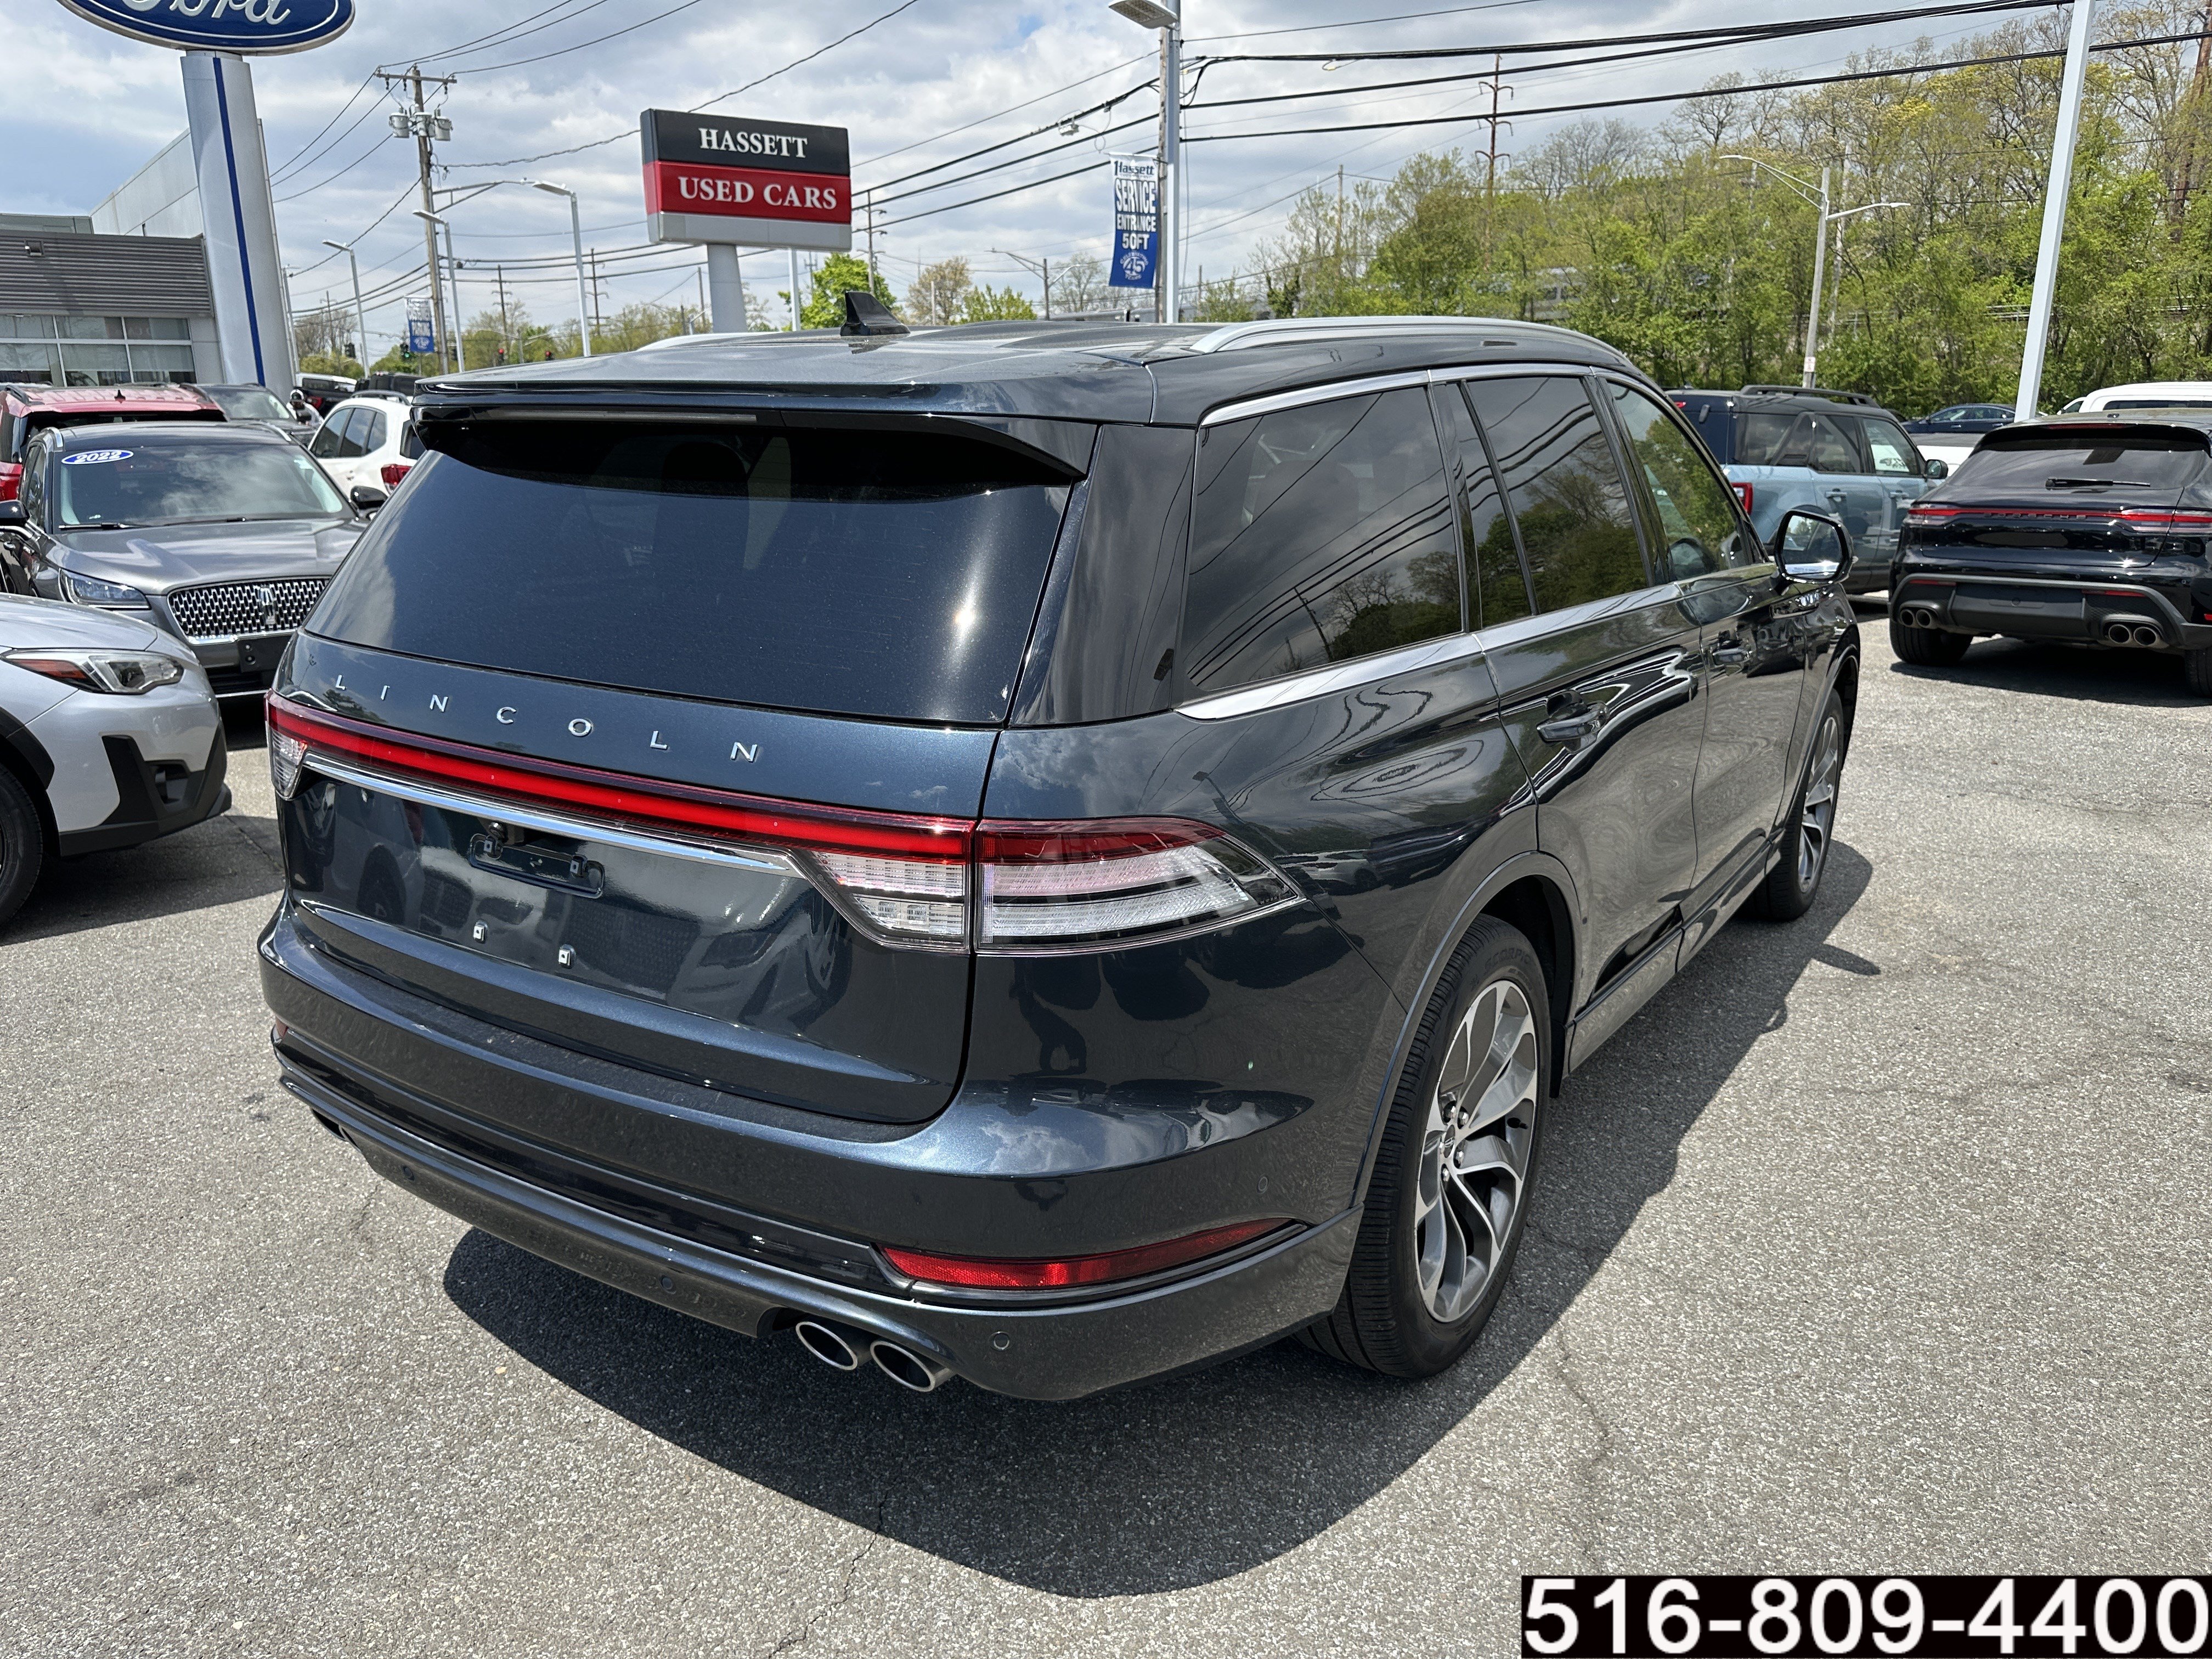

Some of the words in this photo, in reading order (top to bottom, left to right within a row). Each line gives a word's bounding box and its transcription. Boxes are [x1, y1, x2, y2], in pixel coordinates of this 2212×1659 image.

[698, 128, 808, 158] HASSETT
[1114, 161, 1154, 175] Hassett
[678, 176, 754, 203] USED
[763, 184, 837, 210] CARS
[1115, 179, 1156, 214] SERVICE
[1117, 215, 1156, 231] ENTRANCE
[1122, 233, 1150, 250] 50FT
[74, 452, 122, 463] 2022
[335, 674, 758, 763] LINCOLN
